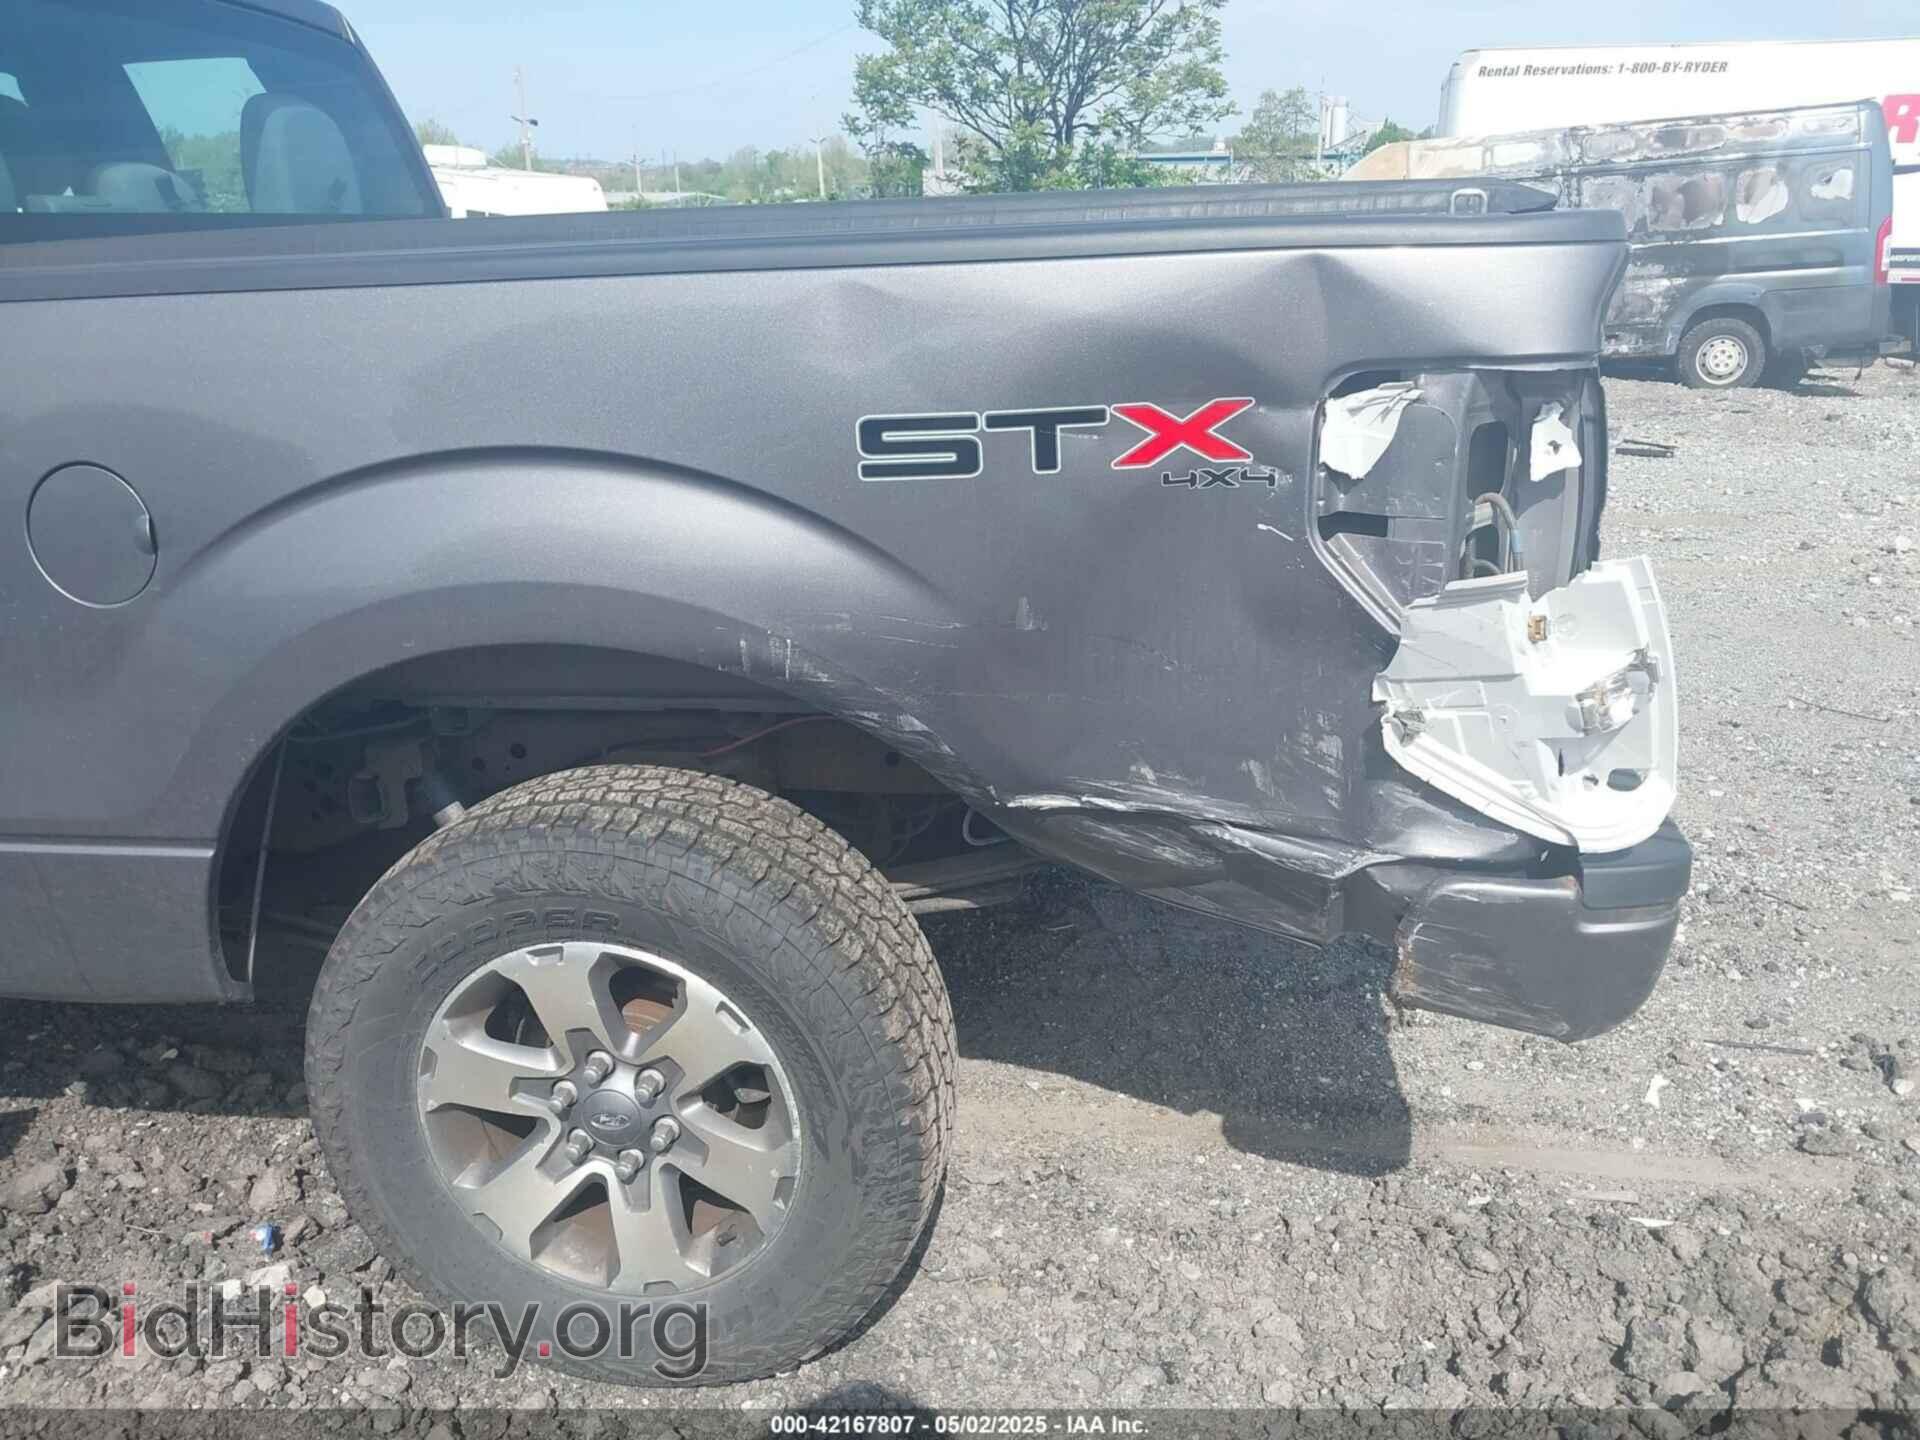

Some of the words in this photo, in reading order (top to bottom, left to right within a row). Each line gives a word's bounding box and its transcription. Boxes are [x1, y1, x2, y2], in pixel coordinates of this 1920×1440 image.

[1478, 65, 1520, 78] Rental
[1523, 62, 1613, 76] Reservations:
[1617, 60, 1728, 75] 1-800-BY-RYDER
[856, 397, 1256, 481] STX
